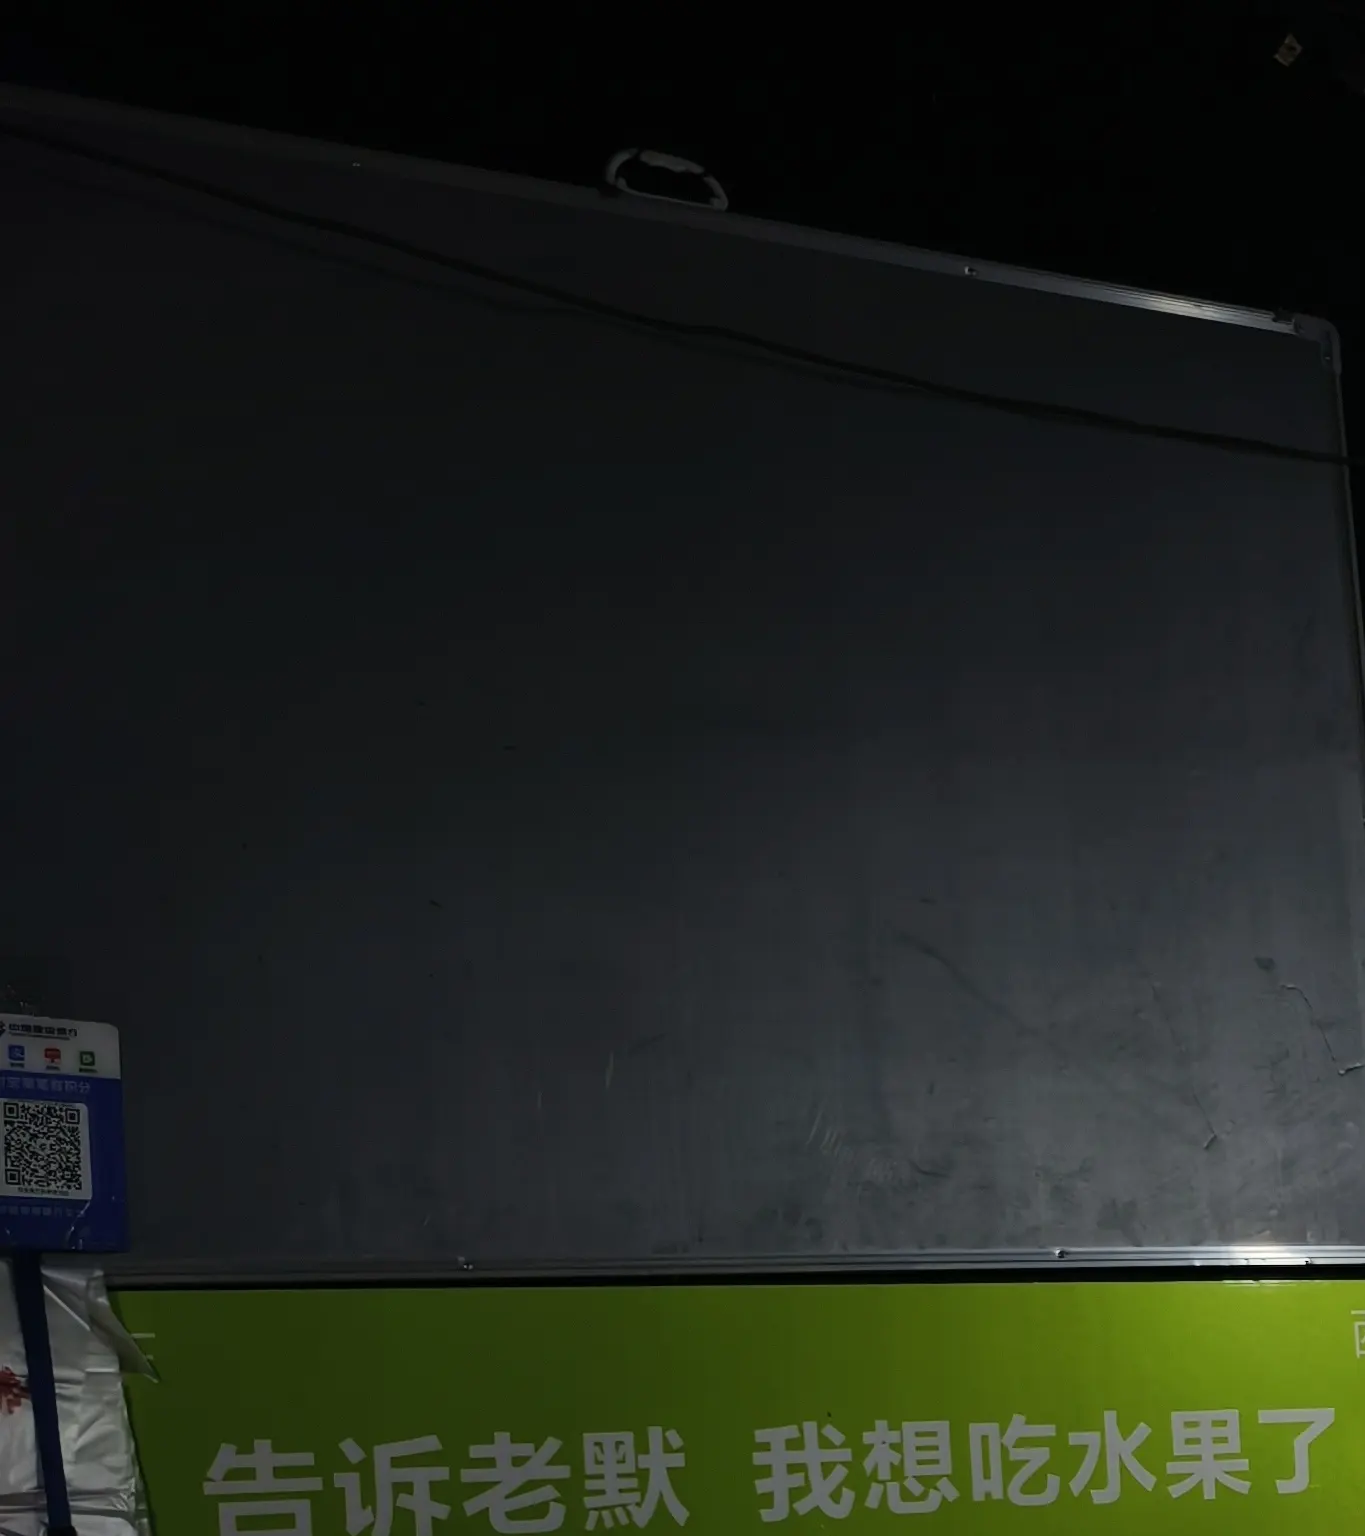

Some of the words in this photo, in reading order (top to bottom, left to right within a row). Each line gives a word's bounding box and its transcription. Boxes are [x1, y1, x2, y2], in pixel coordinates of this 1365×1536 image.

[752, 1407, 1336, 1523] 我想吃水果了
